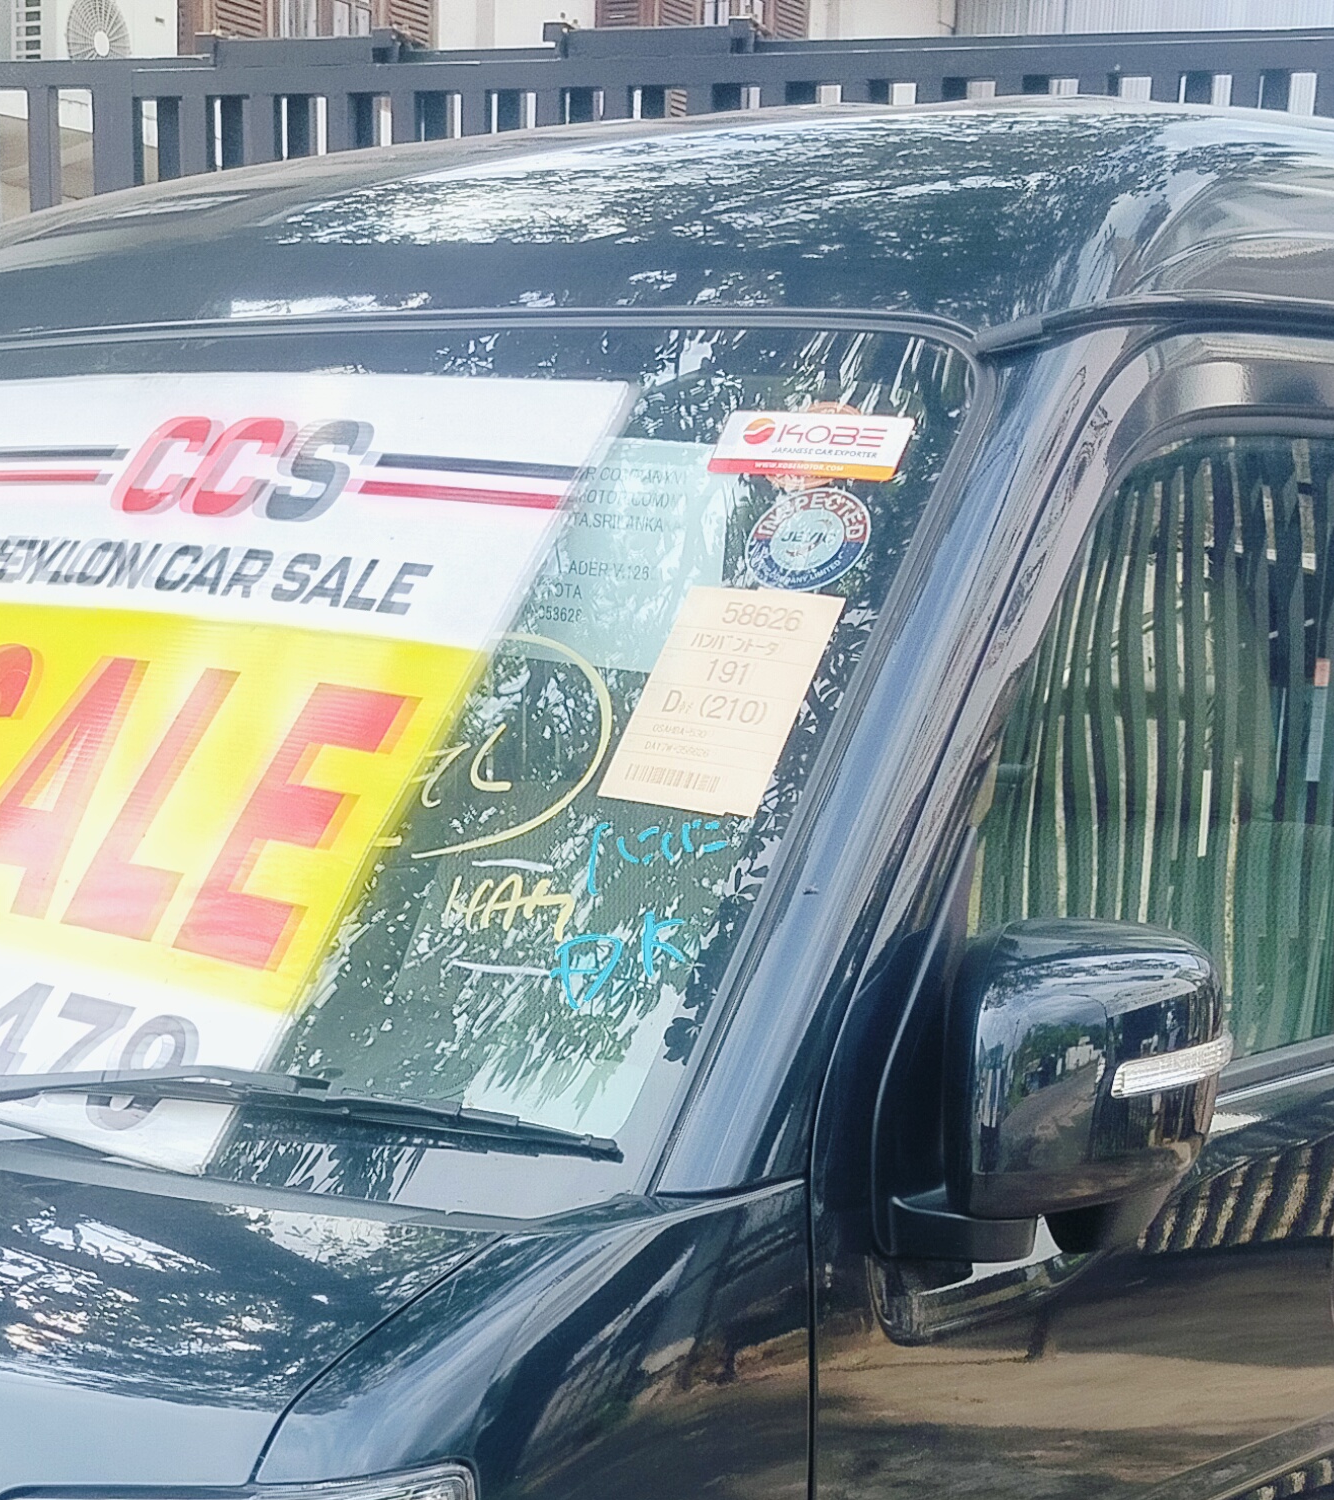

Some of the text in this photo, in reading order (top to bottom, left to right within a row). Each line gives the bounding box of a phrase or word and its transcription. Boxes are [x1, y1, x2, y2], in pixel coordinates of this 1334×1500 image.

[777, 424, 888, 448] KOBE
[771, 447, 878, 459] JAPANESE CAR EXPORTER
[113, 416, 374, 523] CCS
[756, 492, 866, 540] INSPECTED
[155, 544, 275, 599] CAR
[271, 552, 435, 616] SALE
[722, 601, 804, 632] 58626
[706, 658, 751, 686] 191
[700, 694, 768, 725] (210)
